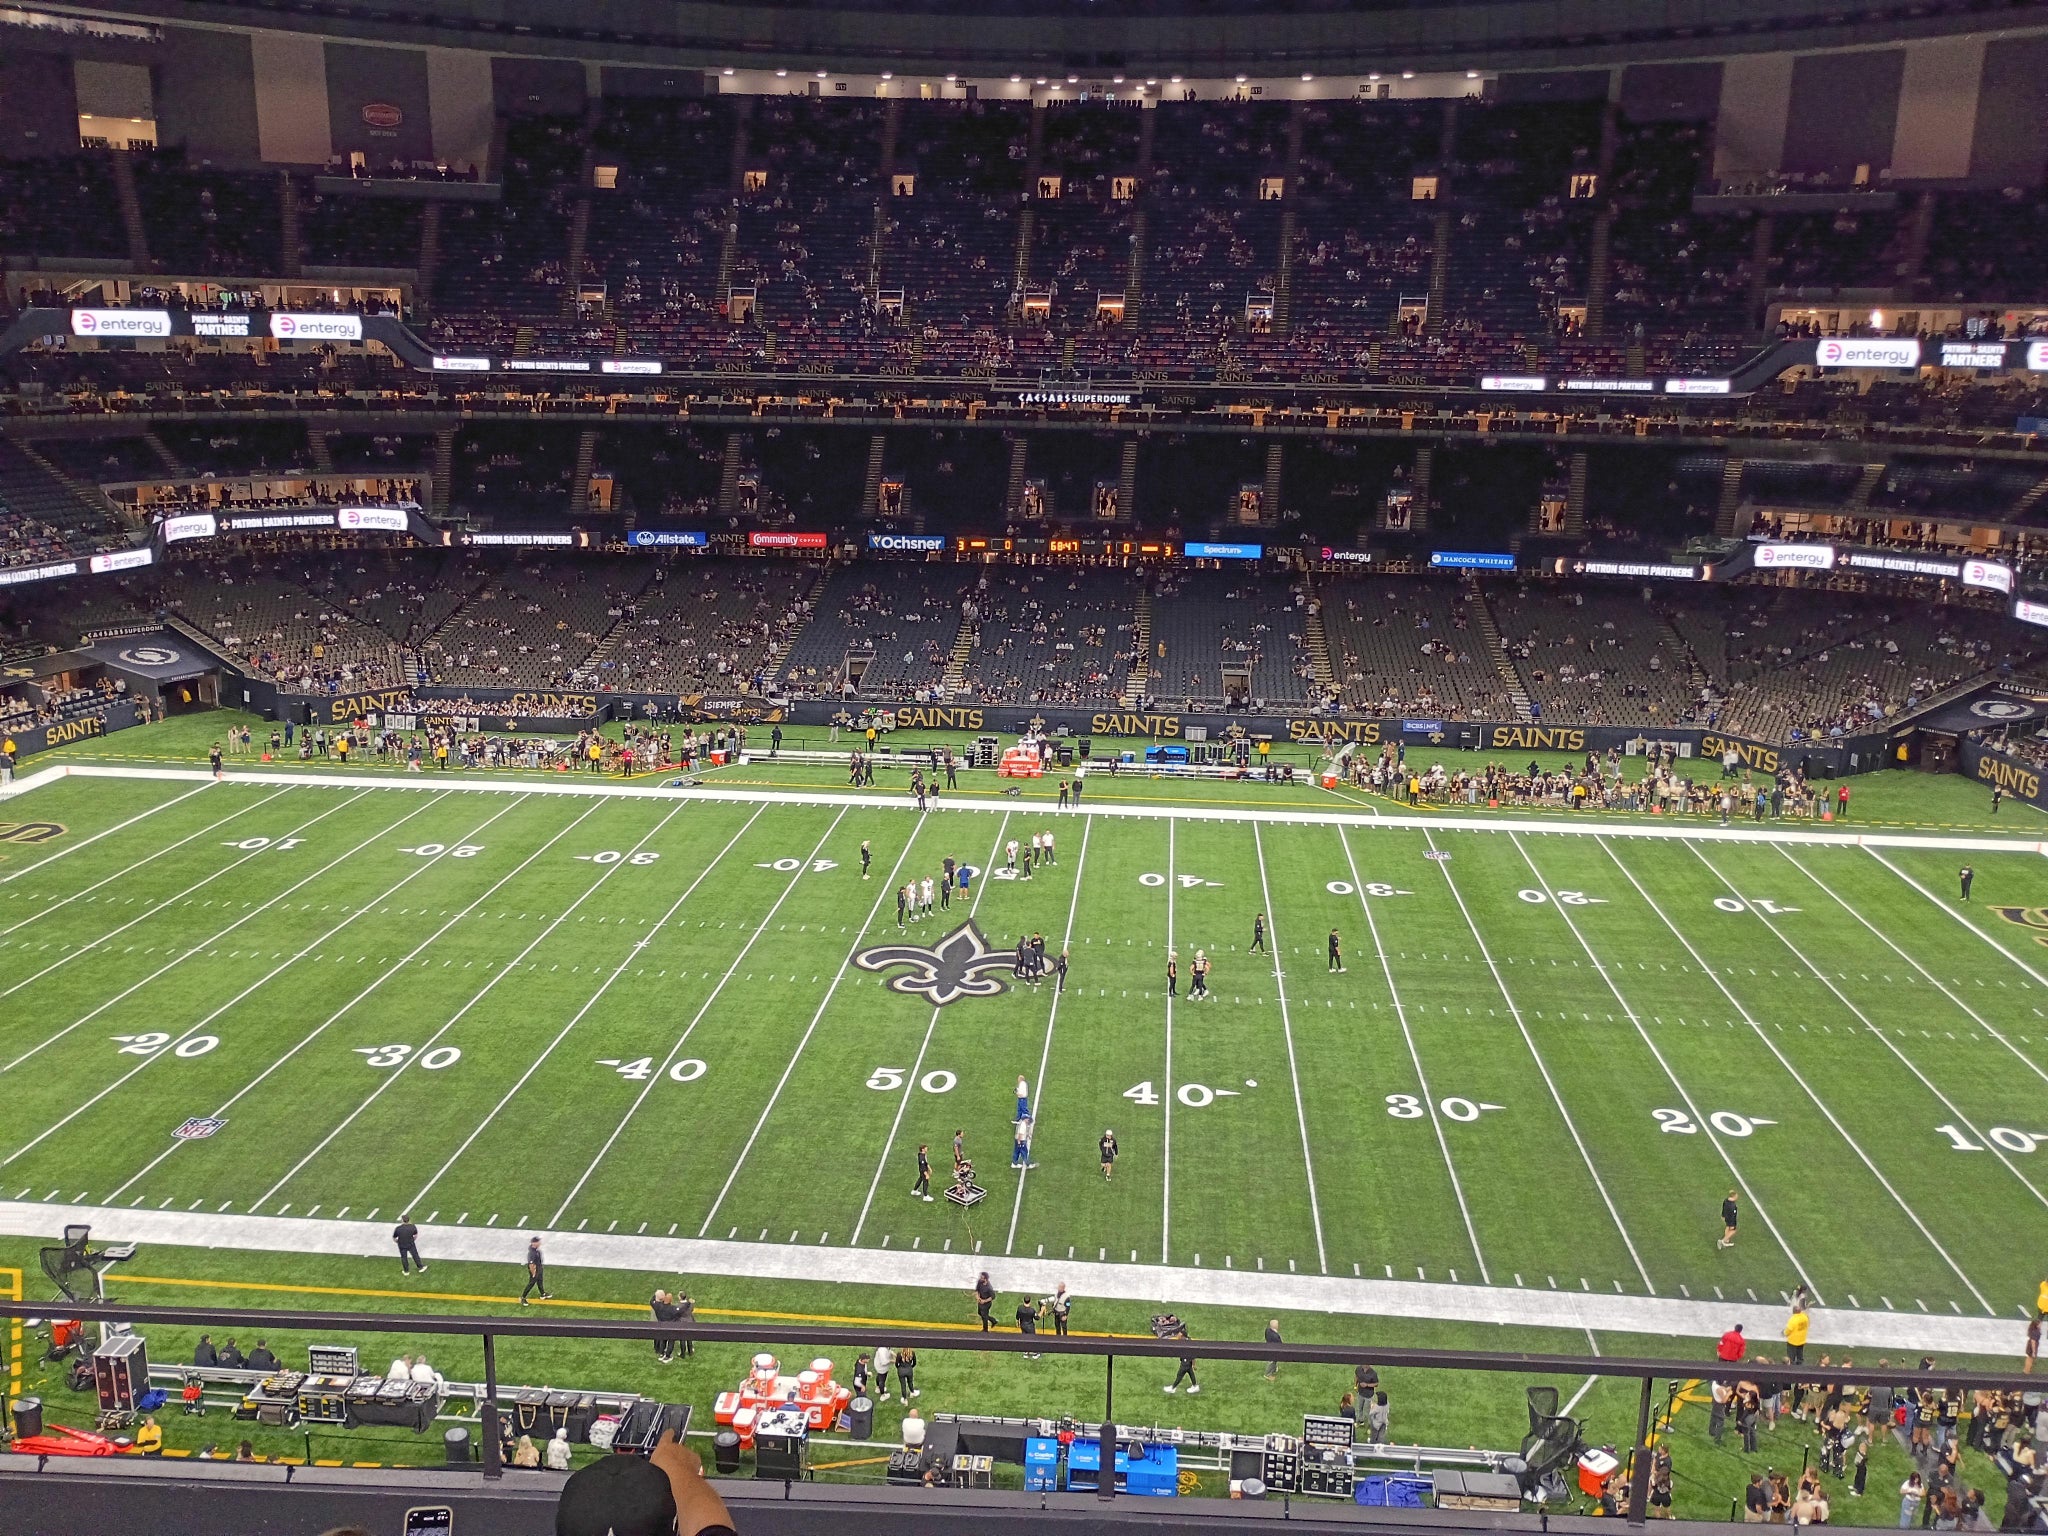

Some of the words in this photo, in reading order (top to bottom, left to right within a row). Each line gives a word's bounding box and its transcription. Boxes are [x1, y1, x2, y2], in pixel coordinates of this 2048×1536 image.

[101, 315, 162, 333] entergy
[191, 314, 217, 325] PATRON
[223, 315, 250, 325] SAINTS
[195, 324, 249, 336] PARTNERS
[300, 321, 356, 338] entergy
[1845, 346, 1909, 364] entergy
[1976, 344, 2006, 354] SAINTS
[511, 360, 537, 370] PATRON
[538, 361, 560, 371] SAINTS
[561, 361, 590, 371] PARTNERS
[1942, 354, 2001, 366] PARTNERS
[714, 362, 752, 373] SAINTS
[797, 365, 834, 375] SAINTS
[879, 366, 916, 376] SAINTS
[961, 368, 997, 377] SAINTS
[1131, 371, 1169, 381] SAINTS
[1215, 373, 1253, 382] SAINTS
[1300, 374, 1339, 384] SAINTS
[1387, 376, 1426, 385] SAINTS
[565, 385, 600, 395] SAINTS
[721, 387, 756, 397] SAINTS
[1567, 381, 1594, 391] PATRON
[1595, 381, 1618, 391] SAINTS
[1619, 381, 1652, 391] PARTNERS
[874, 390, 907, 400] SAINTS
[950, 392, 984, 402] SAINTS
[1018, 393, 1070, 403] CAESARS
[1071, 395, 1131, 404] SUPERDOME
[1161, 395, 1196, 405] SAINTS
[231, 518, 262, 529] PATRON
[263, 516, 296, 527] SAINTS
[297, 515, 335, 526] PARTNERS
[363, 514, 402, 527] entergy
[472, 535, 502, 545] PATRON
[503, 535, 532, 545] SAINTS
[532, 535, 572, 545] PARTNERS
[710, 534, 745, 544] SAINTS
[753, 533, 798, 546] Community
[881, 536, 942, 550] Ochsner
[958, 541, 965, 551] 3
[1004, 540, 1011, 550] 0
[1051, 540, 1079, 552] 68:47
[1123, 542, 1130, 553] 0
[1164, 546, 1171, 556] 3
[1266, 547, 1302, 558] SAINTS
[1333, 550, 1371, 562] entergy
[1443, 556, 1476, 564] HANCOCK
[1478, 558, 1513, 566] WHITNEY
[1776, 551, 1824, 565] entergy
[1586, 563, 1618, 575] PATRON
[1618, 565, 1650, 576] SAINTS
[1650, 566, 1693, 578] PARTNERS
[1851, 555, 1883, 568] PATRON
[1884, 558, 1915, 572] SAINTS
[1916, 561, 1959, 577] PARTNERS
[88, 628, 124, 639] CAESARS
[124, 625, 164, 634] SUPERDOME
[332, 689, 409, 722] SAINTS
[897, 707, 984, 730] SAINTS
[1091, 713, 1180, 737] SAINTS
[46, 717, 102, 746] SAINTS
[1289, 719, 1380, 743] SAINTS
[1493, 726, 1585, 751] SAINTS
[1701, 735, 1779, 774] SAINTS
[1978, 755, 2040, 799] SAINTS
[239, 837, 306, 851] 10
[417, 844, 486, 858] 20
[593, 851, 661, 865] 30
[773, 858, 840, 872] 40
[1138, 873, 1207, 888] 40
[1326, 880, 1396, 897] 30
[1517, 889, 1590, 904] 20
[1713, 897, 1786, 914] 10
[117, 1032, 220, 1058] 20
[366, 1044, 462, 1070] 30
[614, 1056, 708, 1082] 40
[865, 1066, 958, 1094] 50
[1122, 1081, 1217, 1107] 40
[1385, 1093, 1480, 1122] 30
[1651, 1108, 1754, 1137] 20
[180, 1122, 210, 1138] NFL
[1934, 1123, 2037, 1153] 10
[805, 1406, 822, 1424] G
